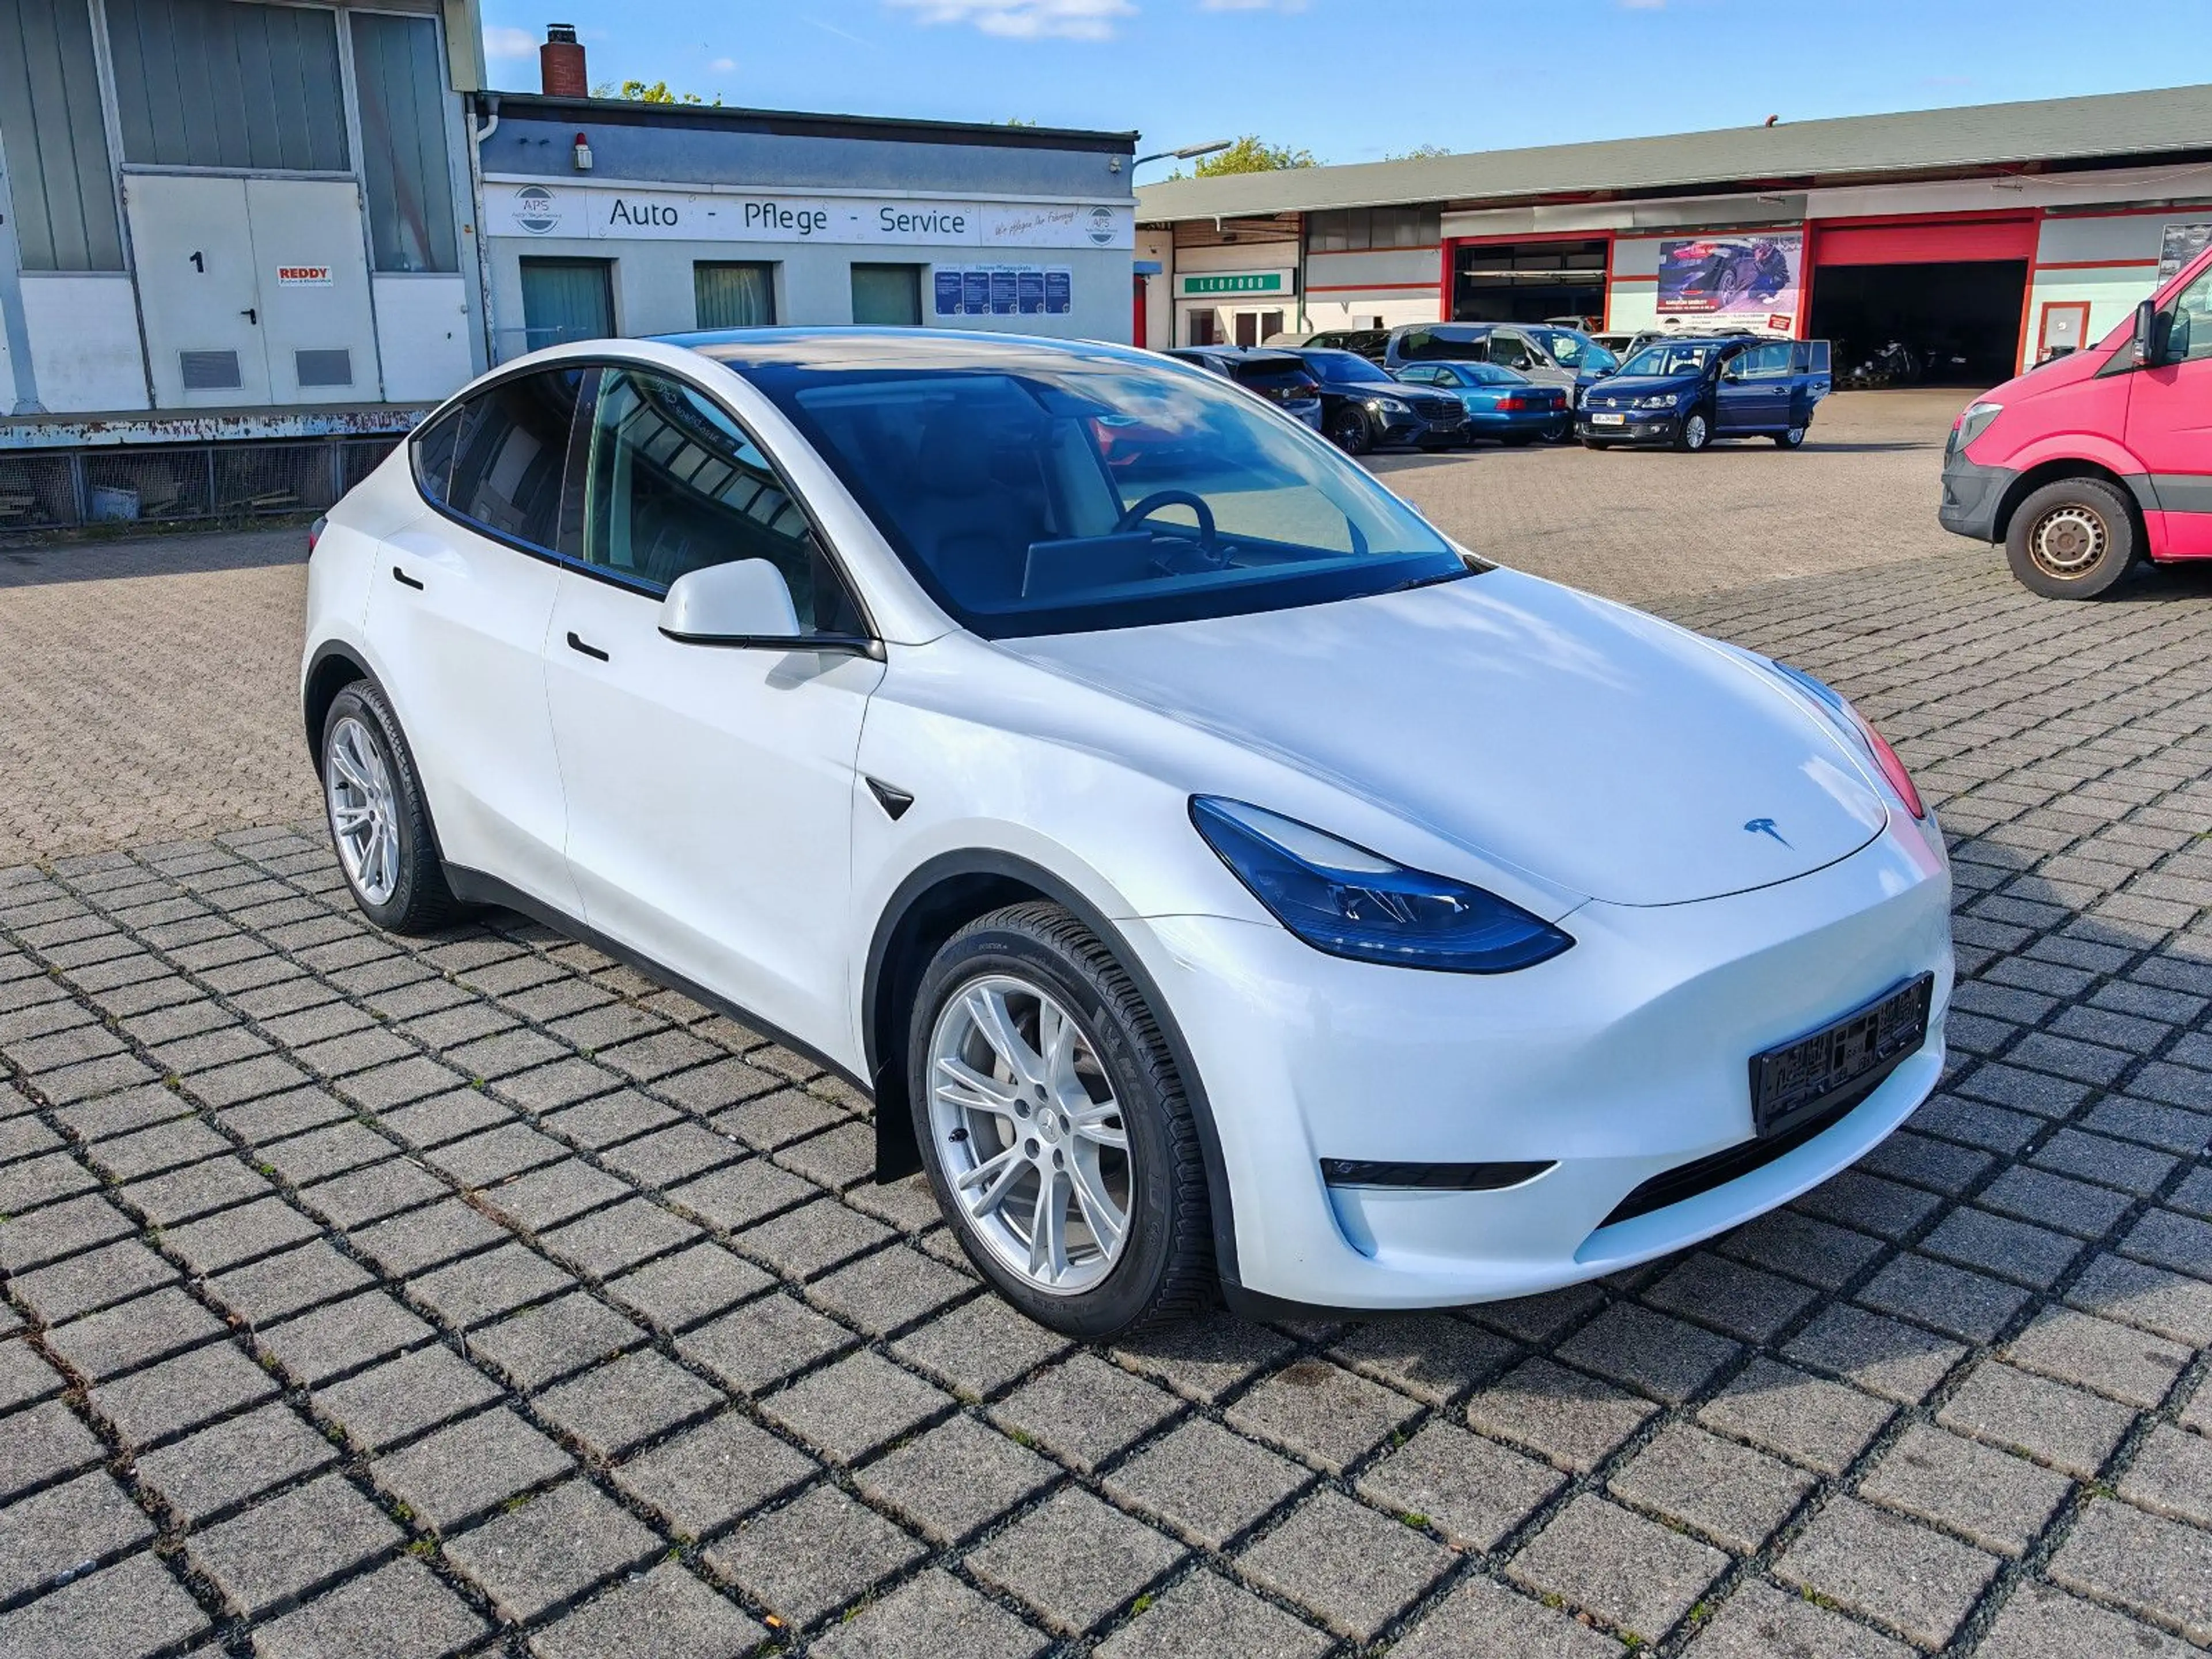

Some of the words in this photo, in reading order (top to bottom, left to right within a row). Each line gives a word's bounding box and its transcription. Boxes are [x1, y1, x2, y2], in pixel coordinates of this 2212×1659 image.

[523, 199, 550, 211] APS
[609, 199, 678, 226] Auto
[745, 203, 827, 235] Pflege
[880, 207, 965, 233] Service
[1093, 218, 1110, 228] APS
[189, 251, 204, 273] 1
[279, 268, 328, 279] REDDY
